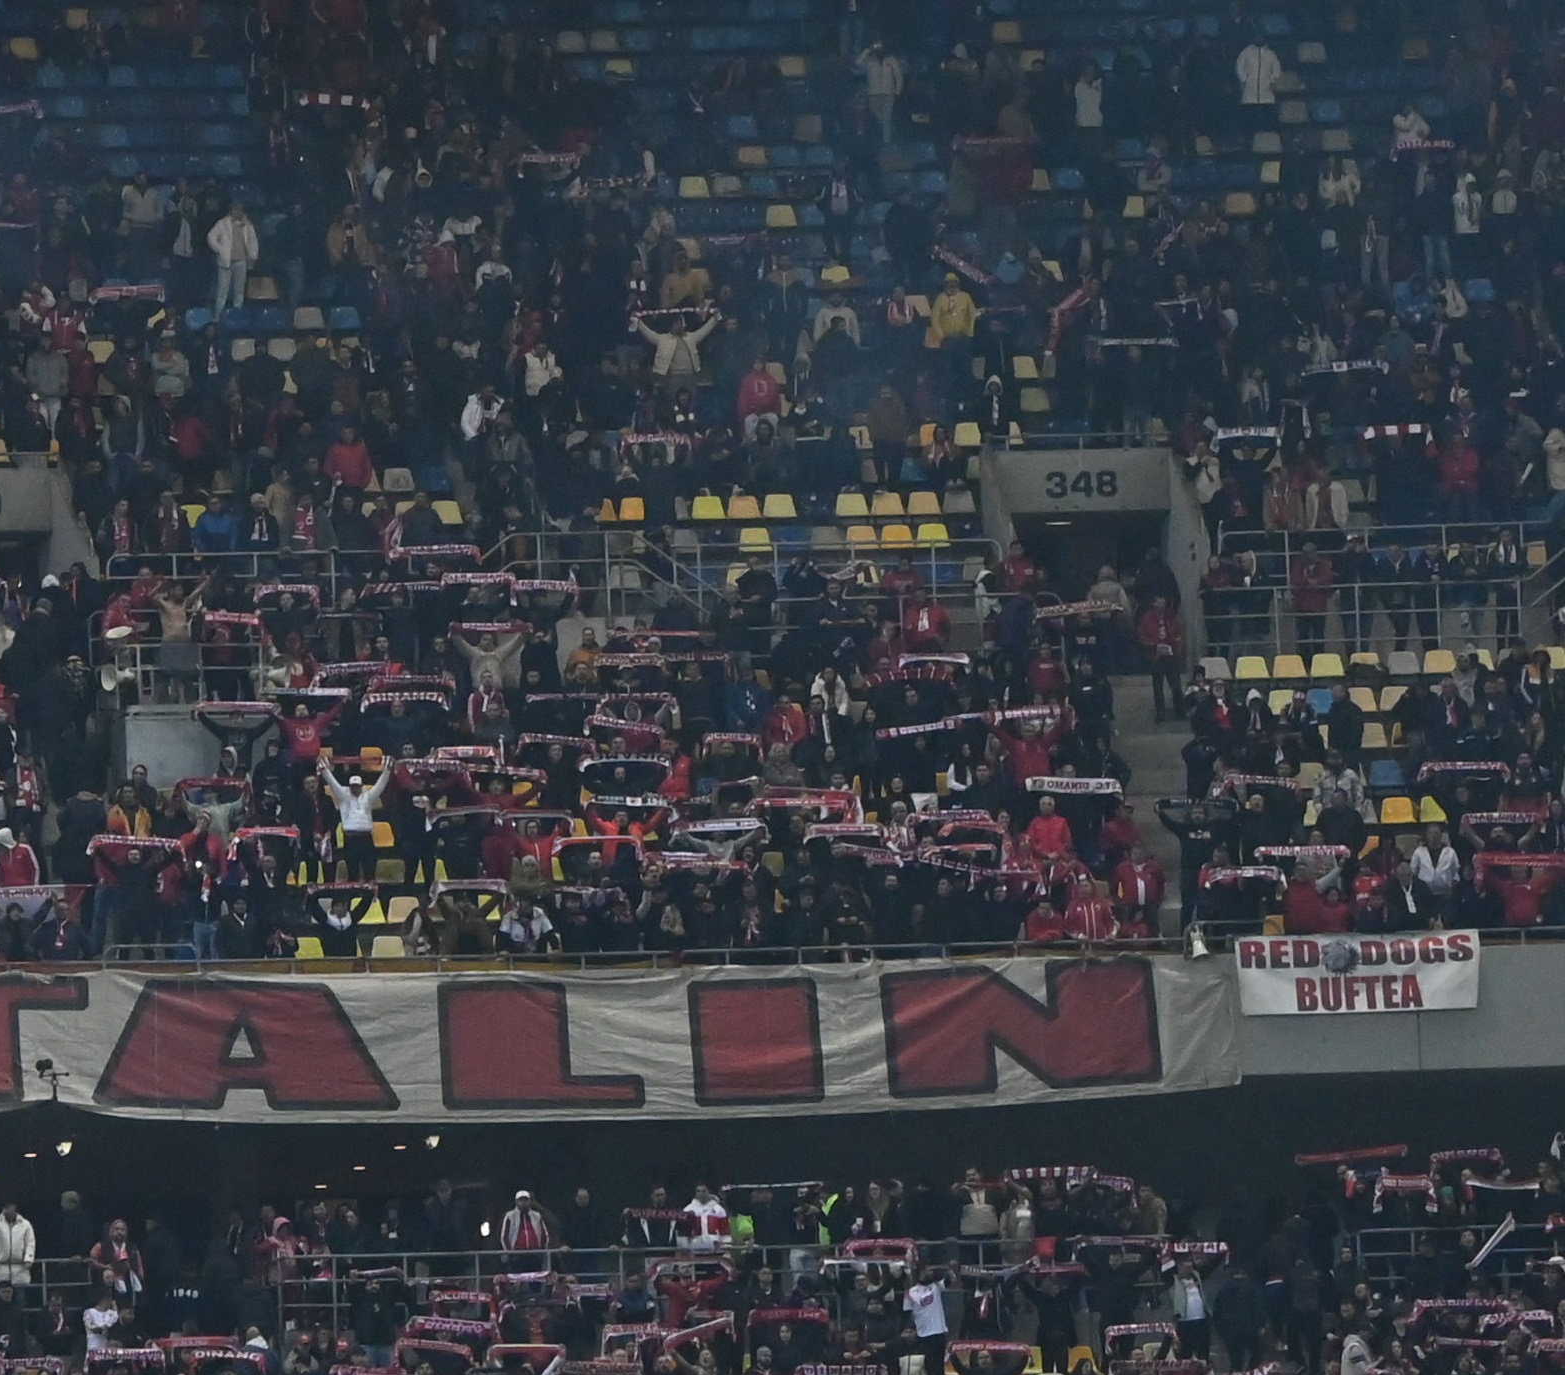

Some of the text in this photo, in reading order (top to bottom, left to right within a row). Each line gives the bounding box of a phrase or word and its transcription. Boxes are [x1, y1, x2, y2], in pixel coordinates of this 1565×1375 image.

[1046, 470, 1119, 498] 348
[1239, 932, 1475, 970] RED DOGS
[1296, 975, 1424, 1012] BUFTEA
[172, 1287, 200, 1298] 1948
[194, 1349, 262, 1360] DINAMO
